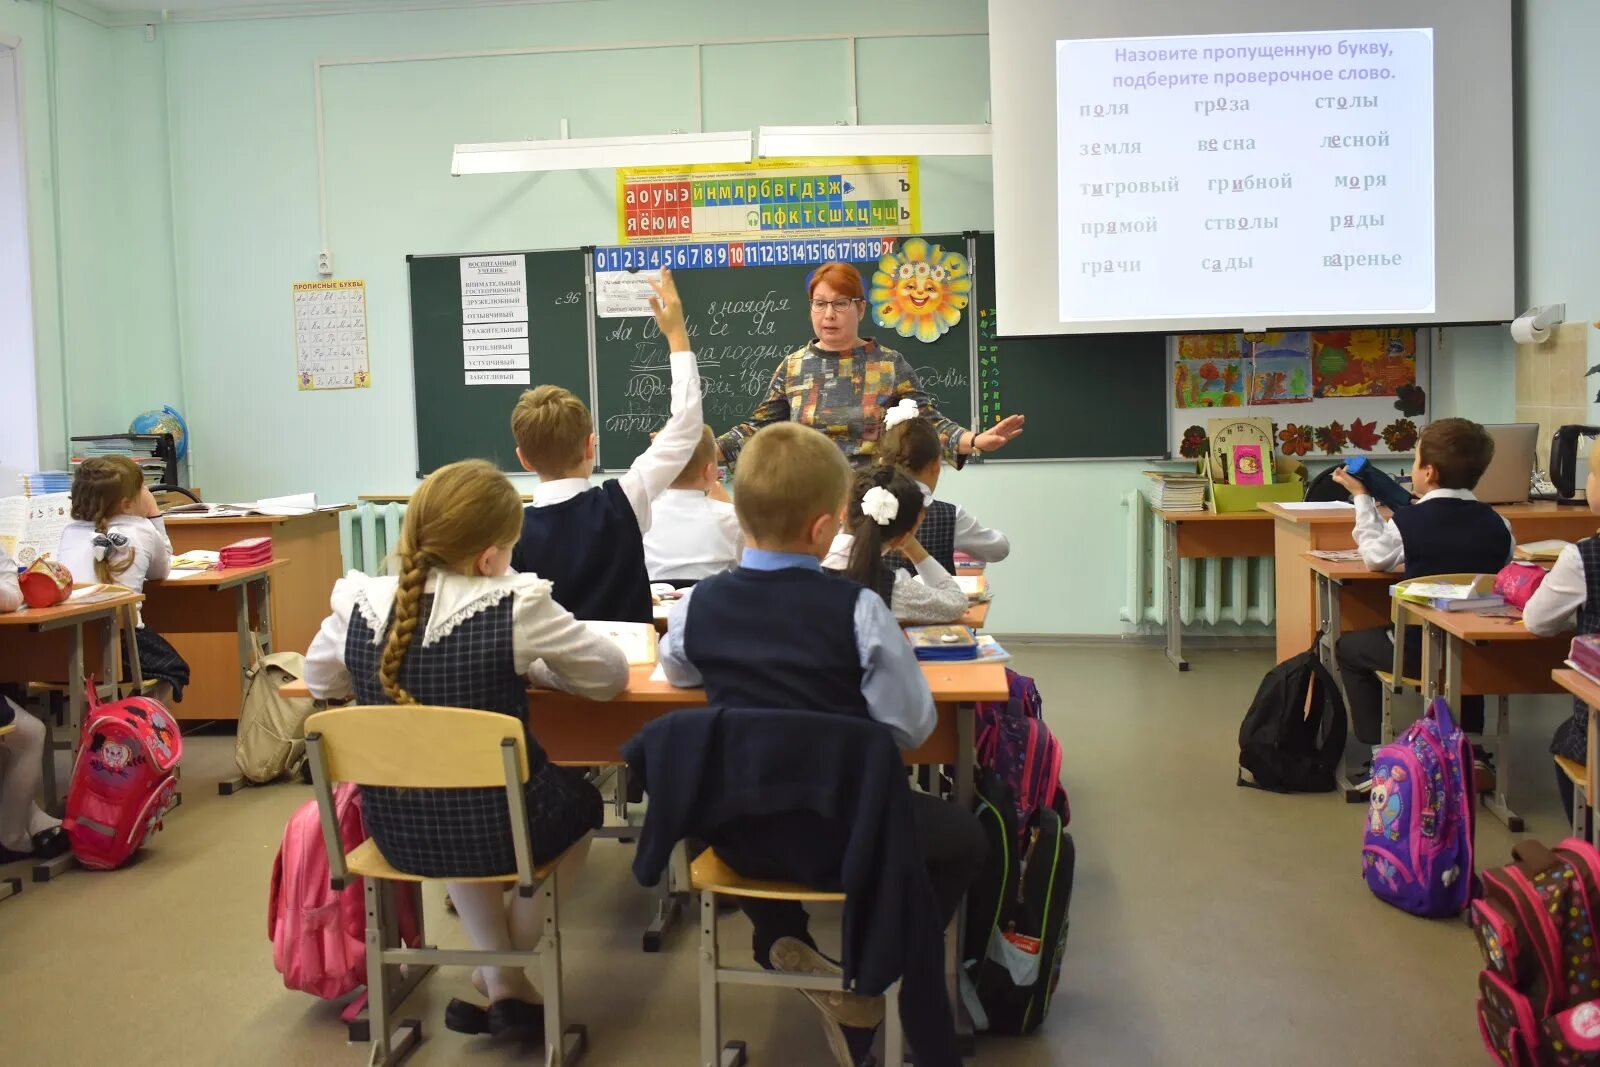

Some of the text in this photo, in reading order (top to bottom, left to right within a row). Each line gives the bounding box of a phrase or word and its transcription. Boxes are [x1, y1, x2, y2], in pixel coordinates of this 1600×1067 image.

[1114, 35, 1394, 66] Назовите пропущенную букву,
[1112, 66, 1397, 93] подберите проверочное слово.
[1079, 93, 1379, 118] поля гроза столы
[1079, 140, 1142, 157] земля
[1320, 130, 1391, 150] лесной
[1080, 176, 1180, 199] тигровый
[1207, 172, 1293, 195] грибной
[1080, 212, 1386, 240] прямой стволы ряды
[597, 252, 605, 268] 0
[611, 251, 618, 267] 1
[624, 251, 632, 267] 2
[637, 250, 645, 266] 3
[651, 250, 659, 266] 4
[664, 249, 672, 265] 5
[677, 249, 685, 265] 6
[690, 248, 699, 264] 7
[704, 248, 713, 264] 8
[718, 247, 726, 263] 9
[730, 247, 743, 262] 10
[745, 246, 758, 262] 11
[760, 245, 774, 261] 12
[776, 244, 789, 261] 13
[791, 244, 805, 260] 14
[807, 243, 820, 260] 15
[822, 242, 836, 259] 16
[837, 242, 851, 259] 17
[853, 241, 866, 258] 18
[868, 241, 881, 258] 19
[1081, 251, 1403, 279] грачи сады варенье
[294, 282, 337, 291] ПРОПИСНЫЕ
[465, 280, 521, 289] ВНИМАТЕЛЬНЫЙ
[466, 298, 520, 307] ДРУЖЕЛЮБНЫЙ
[717, 291, 791, 316] ноября
[467, 311, 514, 320] ОТЗЫВЧИВЫЙ
[605, 319, 632, 341] Аа
[709, 313, 731, 336] Ее
[467, 326, 523, 335] УВАЖИТЕЛЬНЫЙ
[468, 343, 513, 352] ТЕРПЕЛИВЫЙ
[468, 359, 515, 367] УСТУПЧИВЫЙ
[470, 373, 515, 381] ЗАБОТЛИВЫЙ
